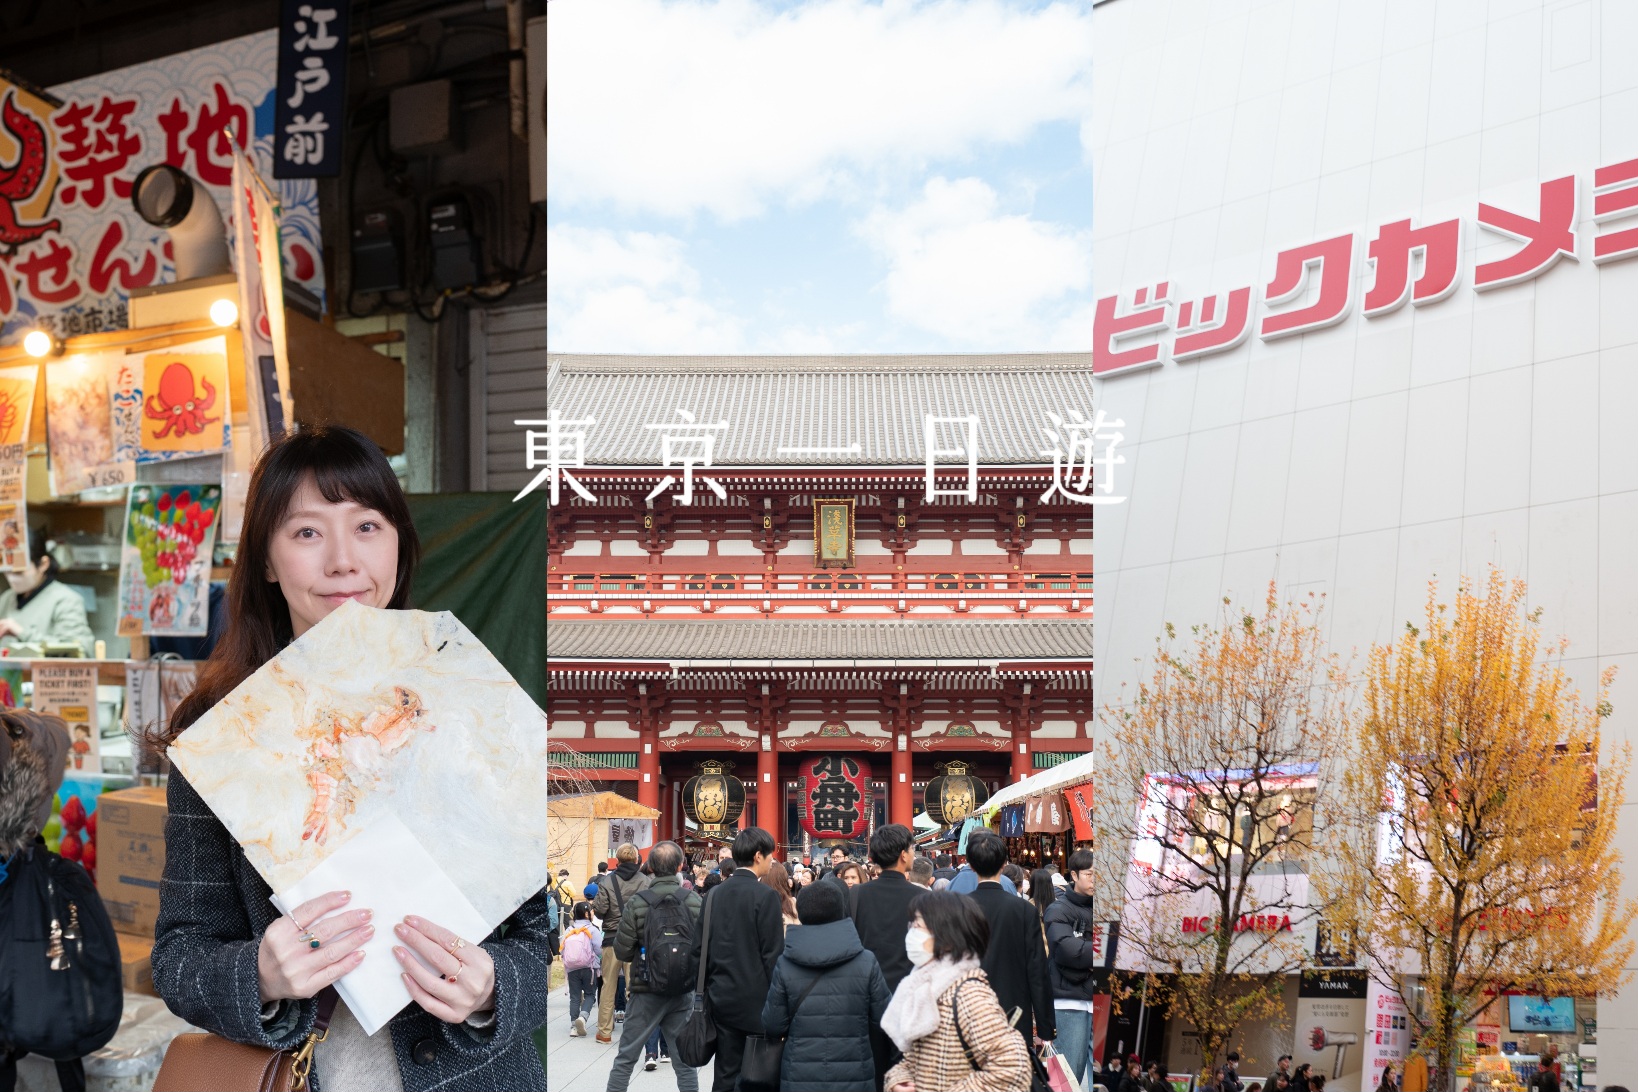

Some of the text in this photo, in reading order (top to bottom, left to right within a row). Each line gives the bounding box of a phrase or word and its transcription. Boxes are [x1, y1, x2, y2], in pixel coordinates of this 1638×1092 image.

[282, 4, 341, 166] 江戸前
[52, 82, 251, 208] 築地
[69, 669, 84, 677] BUY
[1181, 916, 1210, 933] BIC
